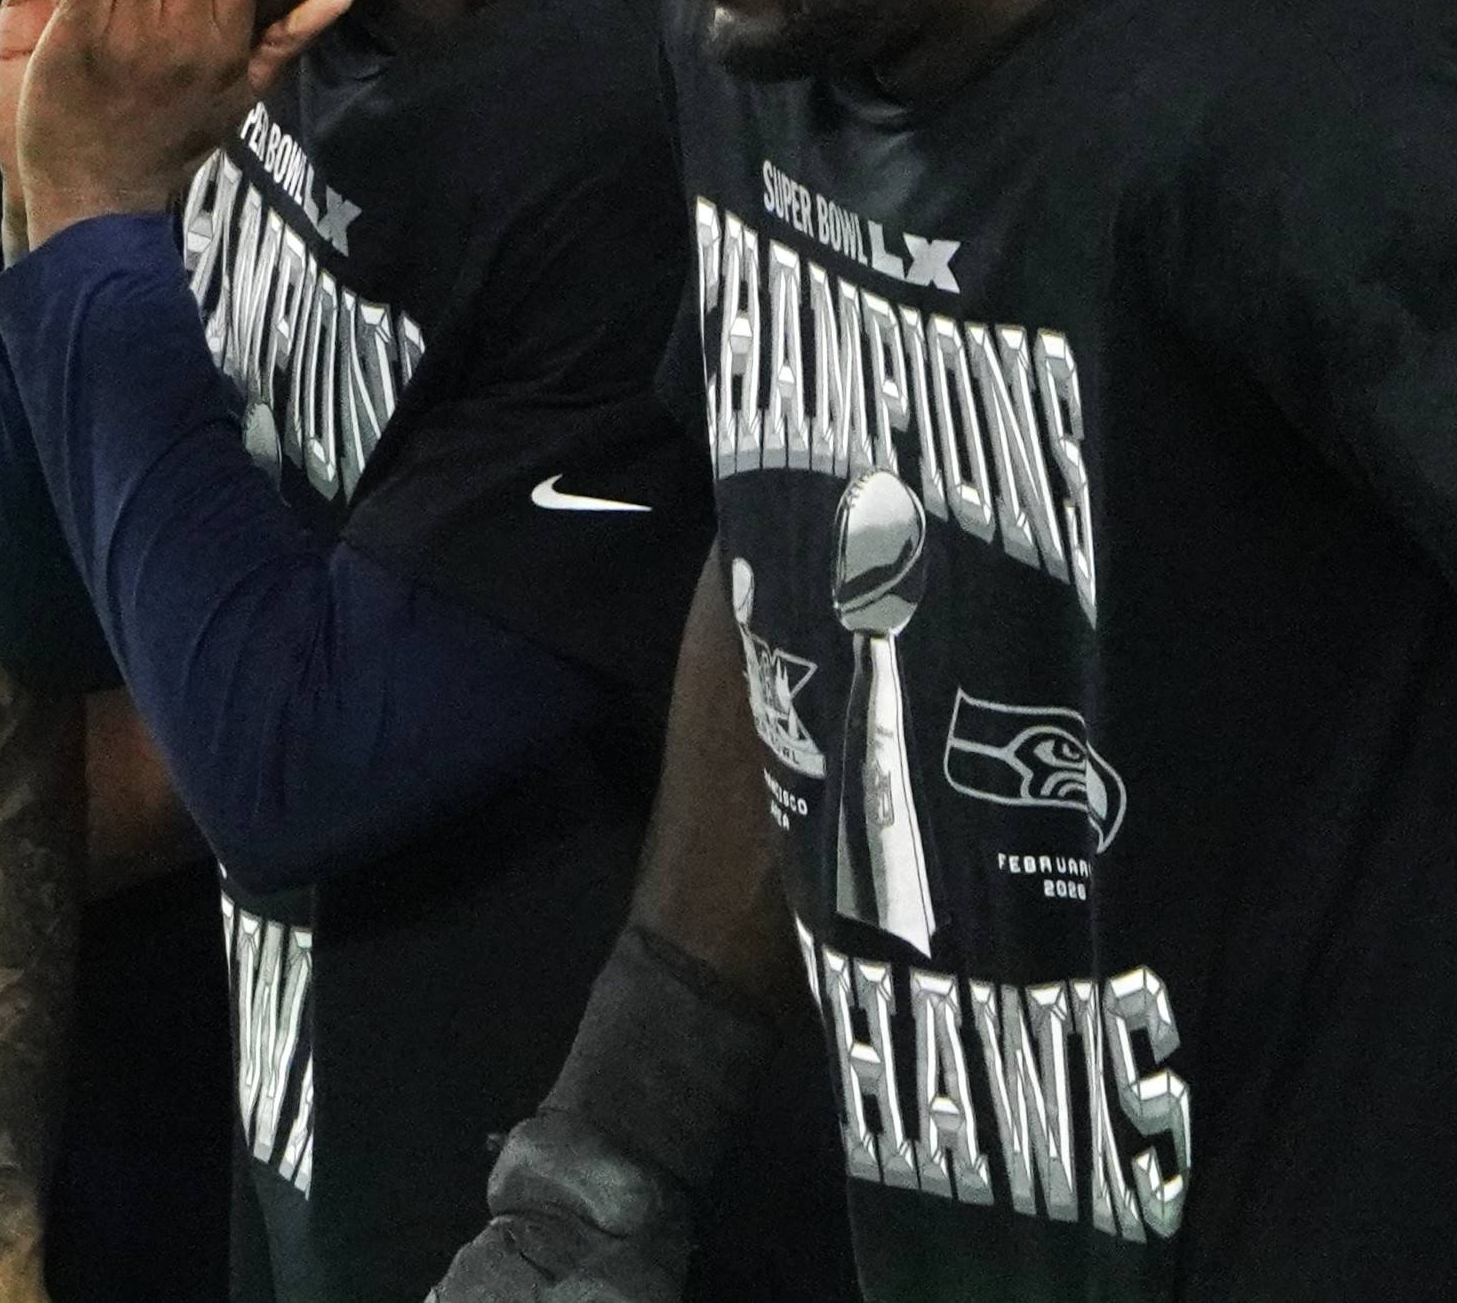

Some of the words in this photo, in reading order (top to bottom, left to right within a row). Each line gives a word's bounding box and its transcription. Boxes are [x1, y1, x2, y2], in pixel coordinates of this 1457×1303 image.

[262, 122, 307, 206] BOWL
[303, 161, 364, 258] LX
[761, 158, 815, 239] SUPER
[816, 192, 870, 268] BOWL
[867, 217, 963, 294] LX
[997, 851, 1093, 879] FEBRUAR
[795, 910, 1192, 1245] HAWKS
